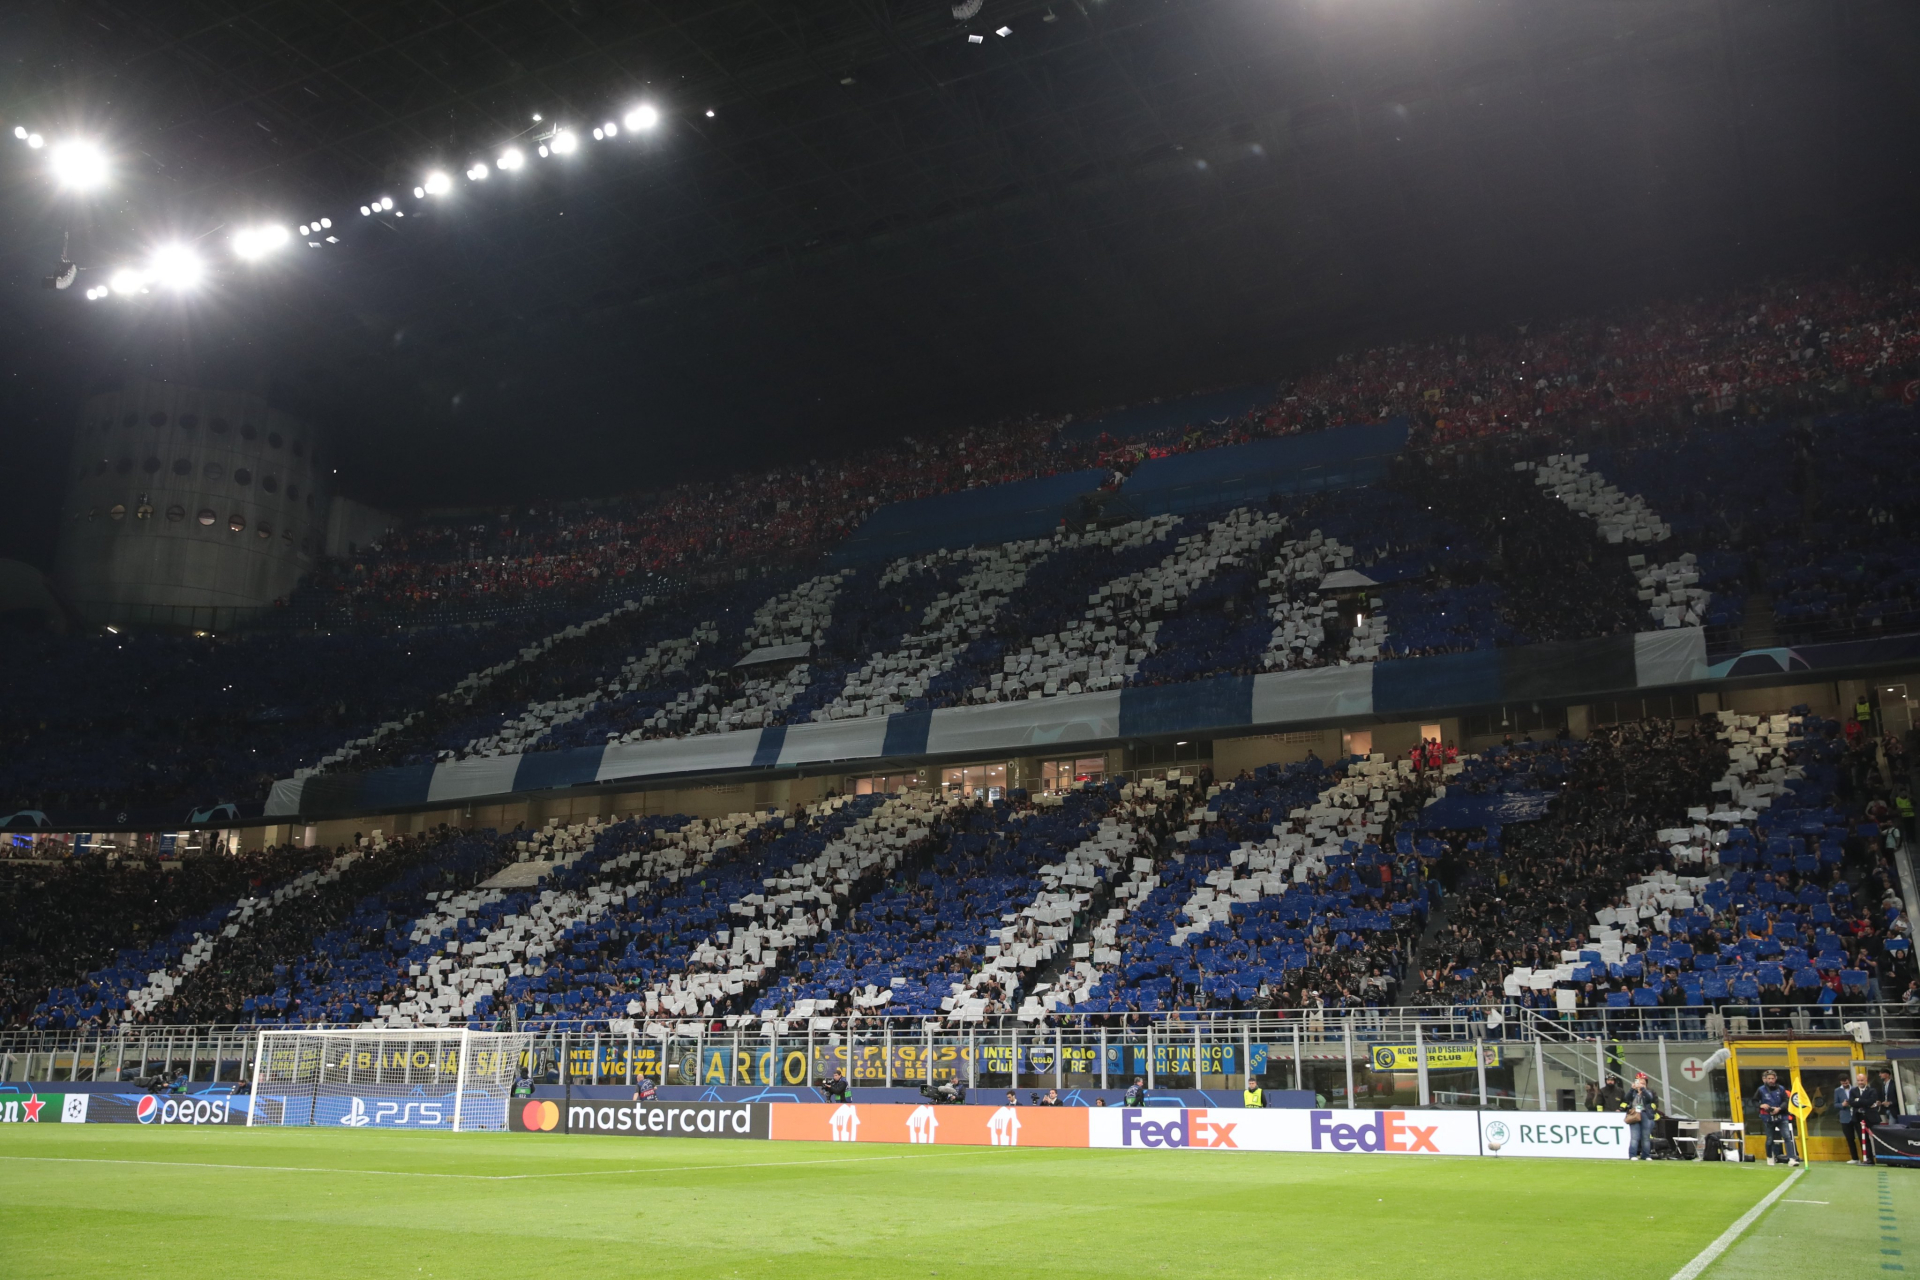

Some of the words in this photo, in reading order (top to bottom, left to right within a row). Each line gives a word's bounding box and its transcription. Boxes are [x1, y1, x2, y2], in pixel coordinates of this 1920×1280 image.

[623, 1049, 656, 1060] CLUB
[984, 1046, 1022, 1059] INTER
[1439, 1046, 1474, 1054] D'ISERNIA
[601, 1062, 665, 1076] VIGZZO
[704, 1051, 807, 1085] ARCO
[836, 1067, 899, 1079] NCOLA
[1071, 1060, 1086, 1073] RE
[161, 1094, 231, 1125] pepsi
[375, 1102, 442, 1124] PS5
[568, 1102, 751, 1133] mastercard
[1121, 1108, 1239, 1148] FedEx
[1310, 1110, 1441, 1152] FedEx
[1520, 1124, 1624, 1145] RESPECT
